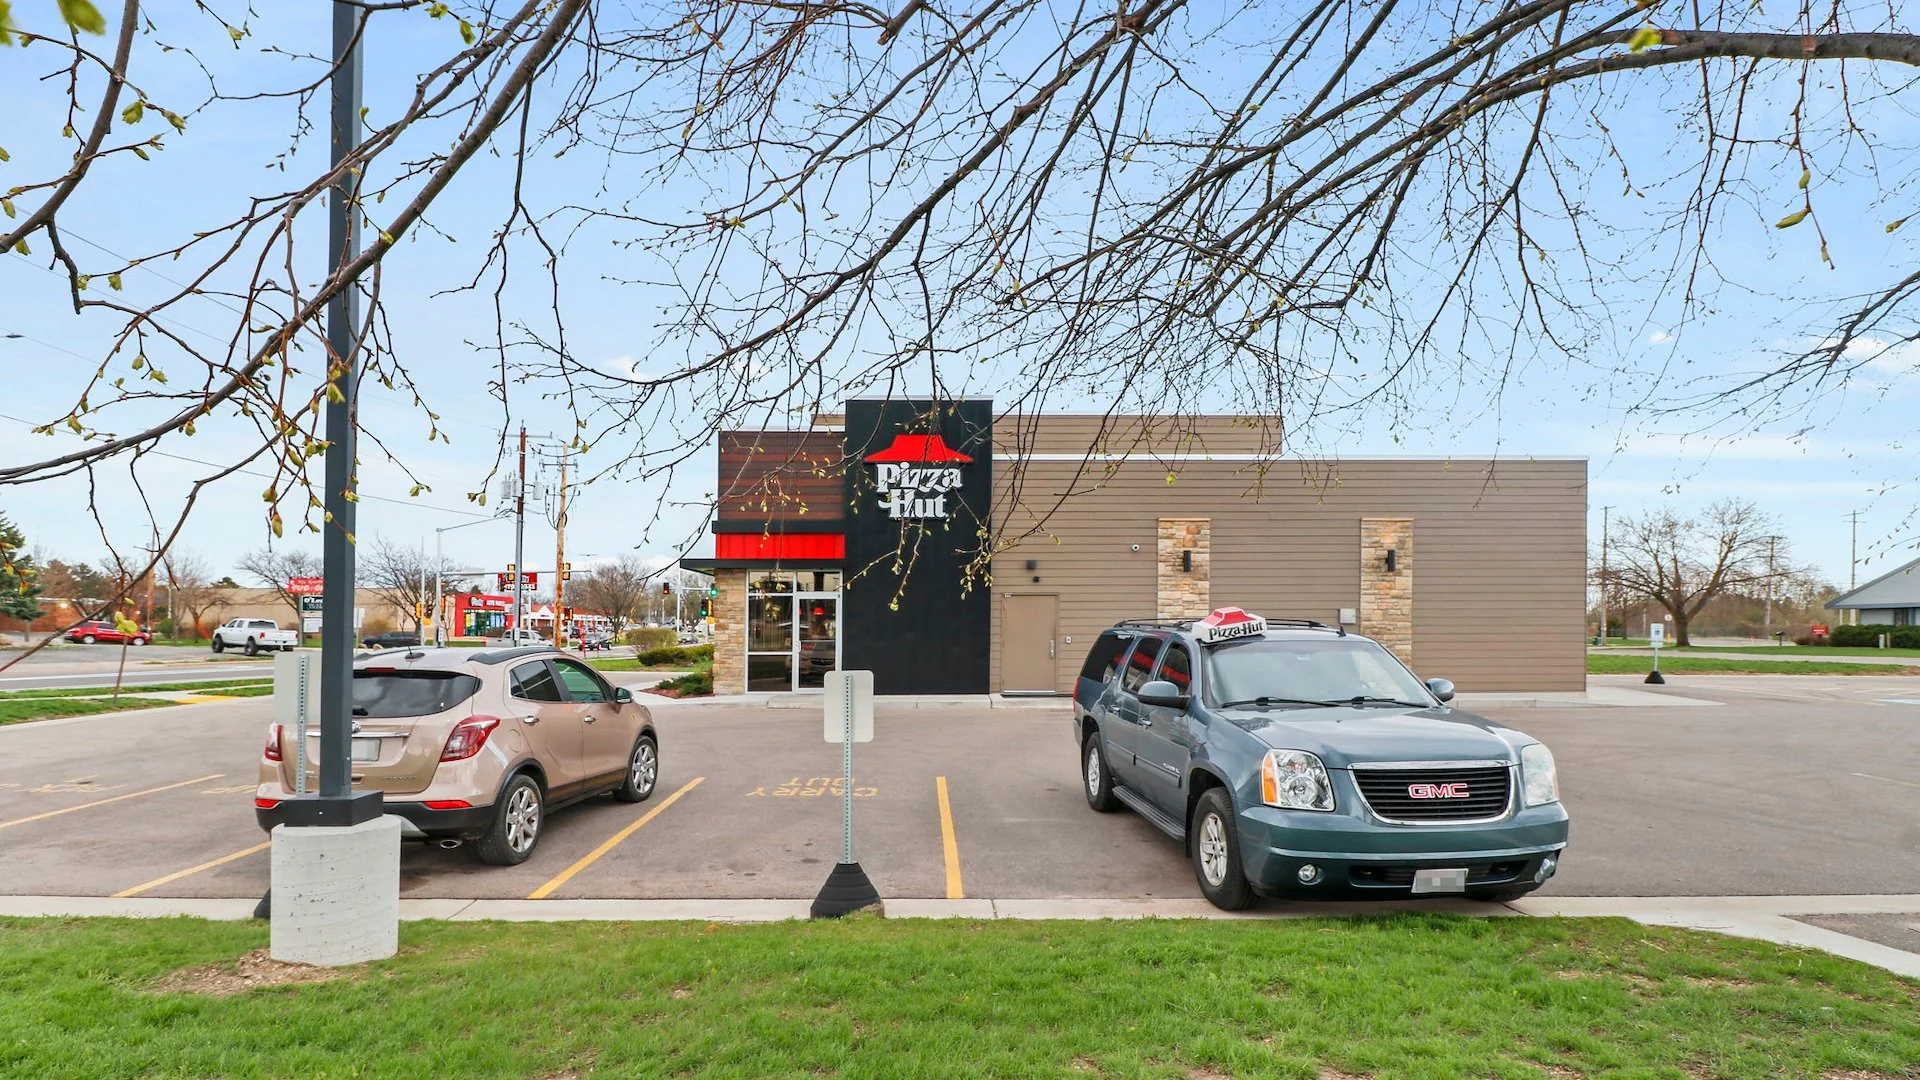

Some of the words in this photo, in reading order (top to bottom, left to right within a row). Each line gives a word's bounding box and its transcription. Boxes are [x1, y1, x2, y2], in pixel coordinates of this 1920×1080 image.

[876, 462, 963, 493] Pizza
[877, 488, 947, 518] Hut
[1208, 625, 1240, 640] Pizza
[1240, 622, 1263, 635] Hut
[1408, 783, 1470, 798] GMC
